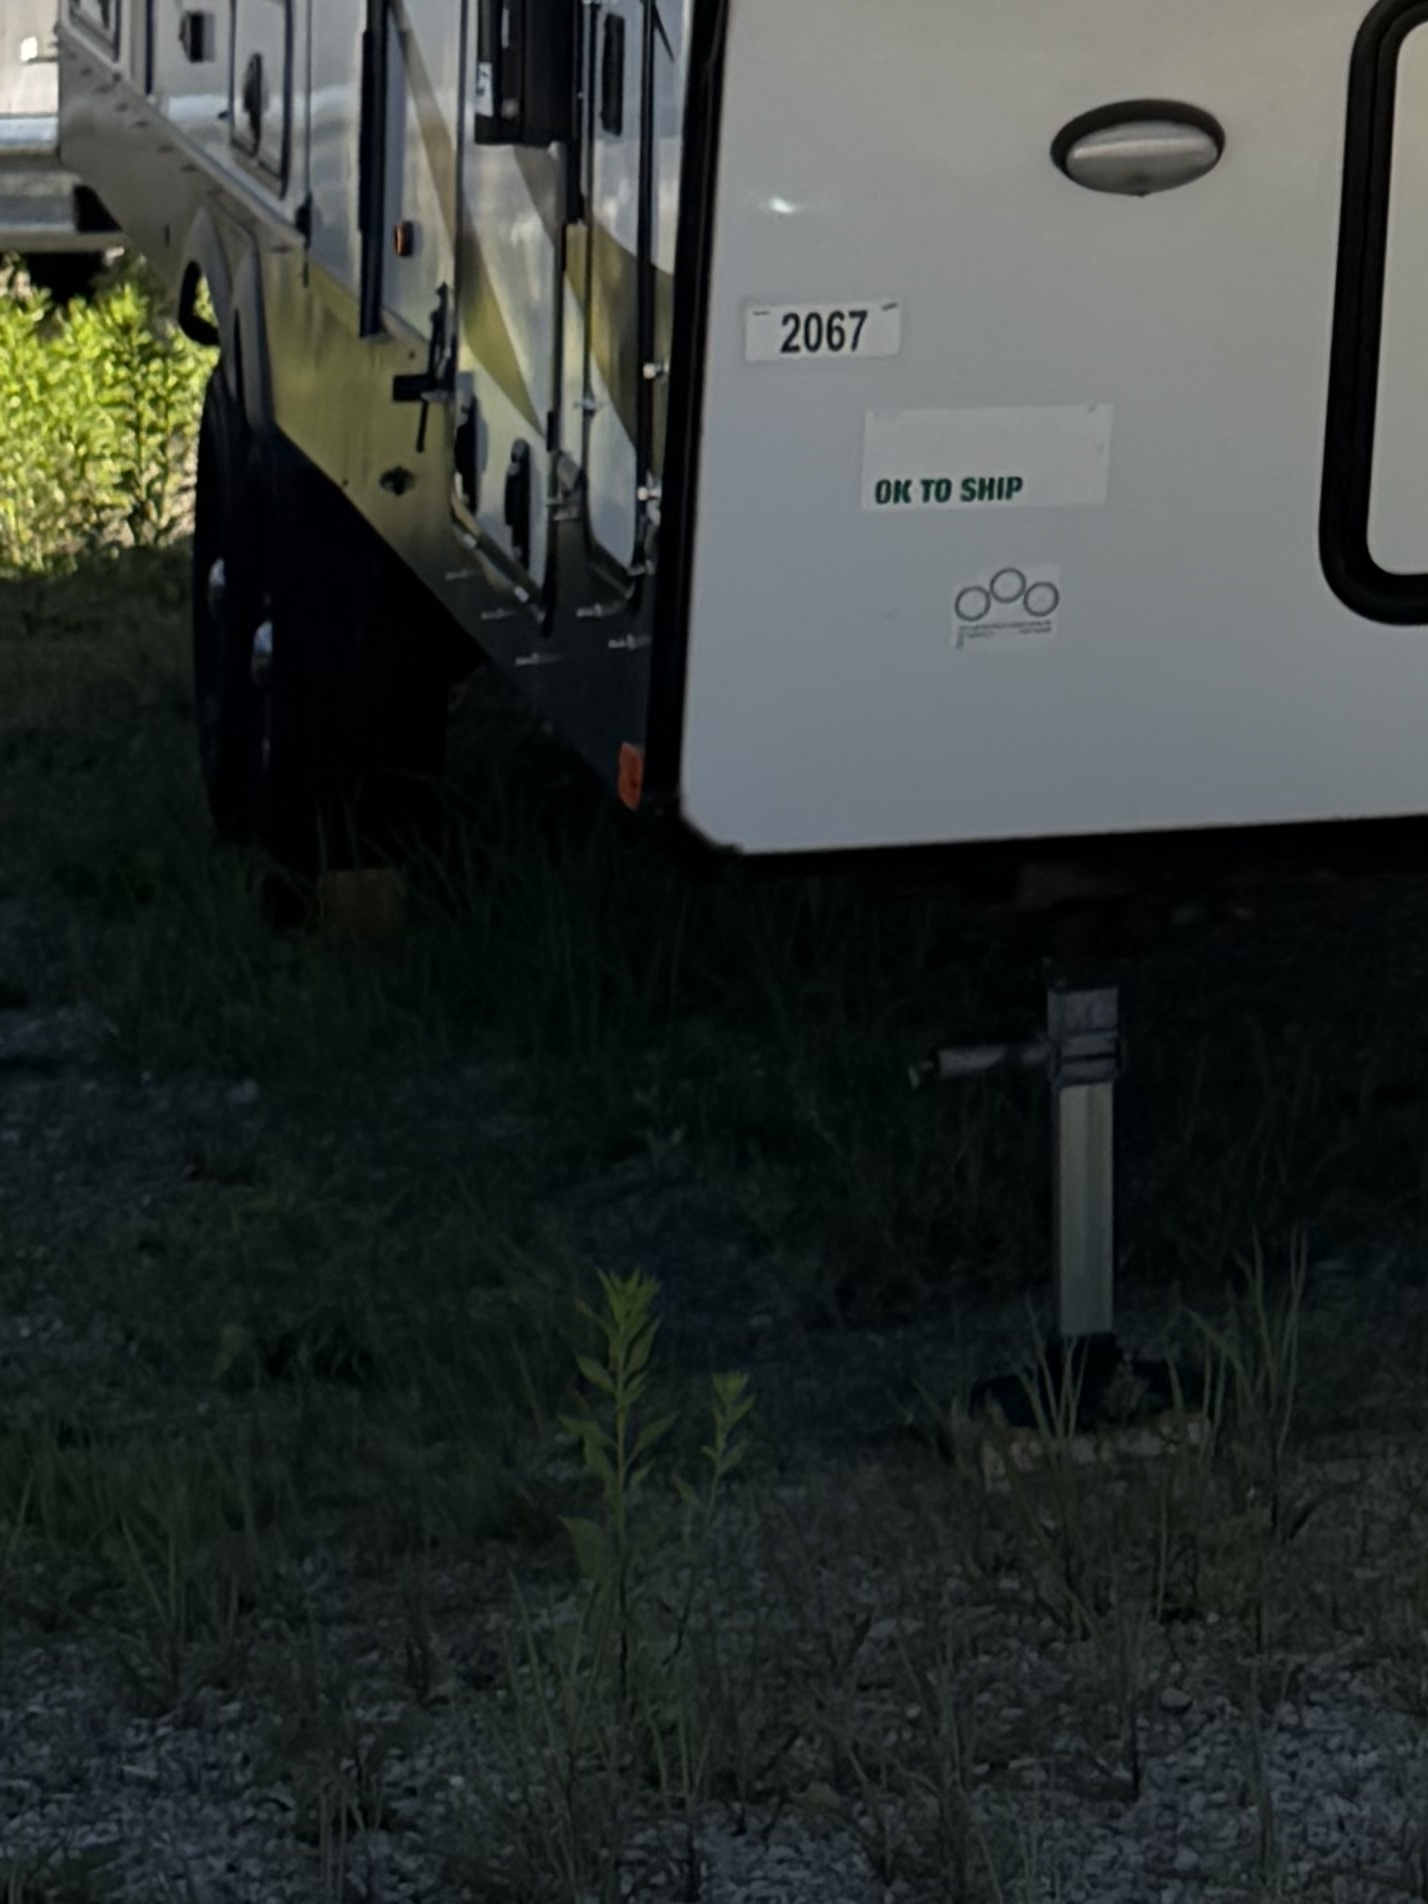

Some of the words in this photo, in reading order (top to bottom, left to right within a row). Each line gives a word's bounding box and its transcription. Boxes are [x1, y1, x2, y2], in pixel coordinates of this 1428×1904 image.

[780, 310, 868, 354] 2067
[875, 479, 912, 504] OK
[921, 478, 952, 503] TO
[960, 476, 1023, 503] SHIP
